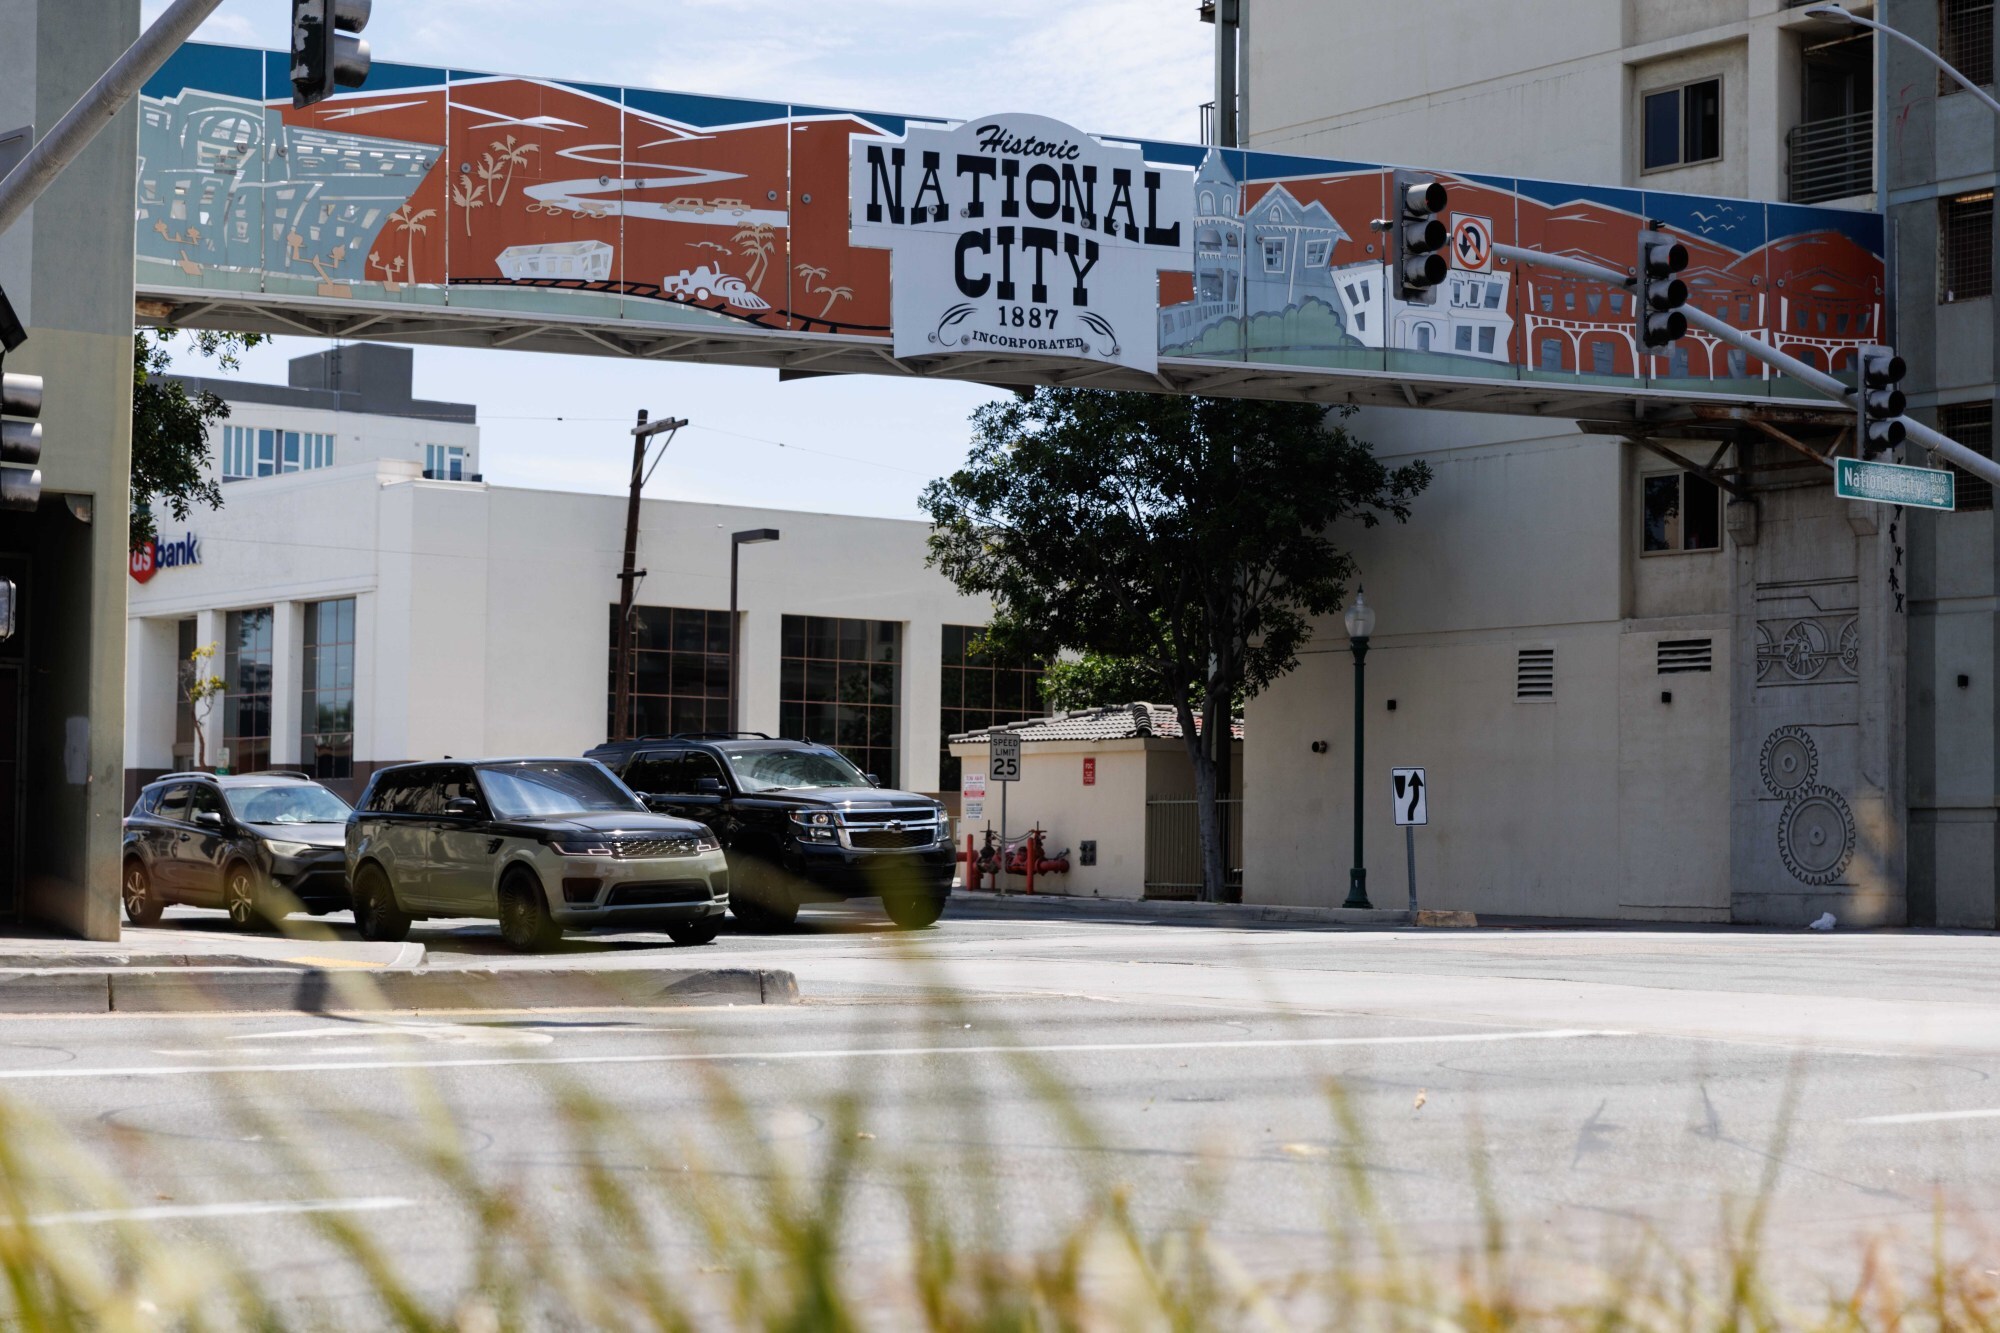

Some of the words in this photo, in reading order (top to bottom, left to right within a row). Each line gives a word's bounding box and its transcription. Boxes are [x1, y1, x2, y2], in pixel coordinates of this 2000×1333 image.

[976, 124, 1080, 160] Historic
[867, 145, 1180, 247] NATIONAL
[954, 225, 1099, 306] CITY
[999, 305, 1058, 330] 1887
[972, 330, 1084, 350] INCORPORATED
[1844, 466, 1894, 491] Nationa
[1899, 473, 1922, 500] City
[1930, 472, 1947, 484] BLVD
[155, 531, 197, 568] bank
[993, 738, 1018, 747] SPEED
[995, 748, 1015, 757] LIMIT
[993, 758, 1017, 775] 25
